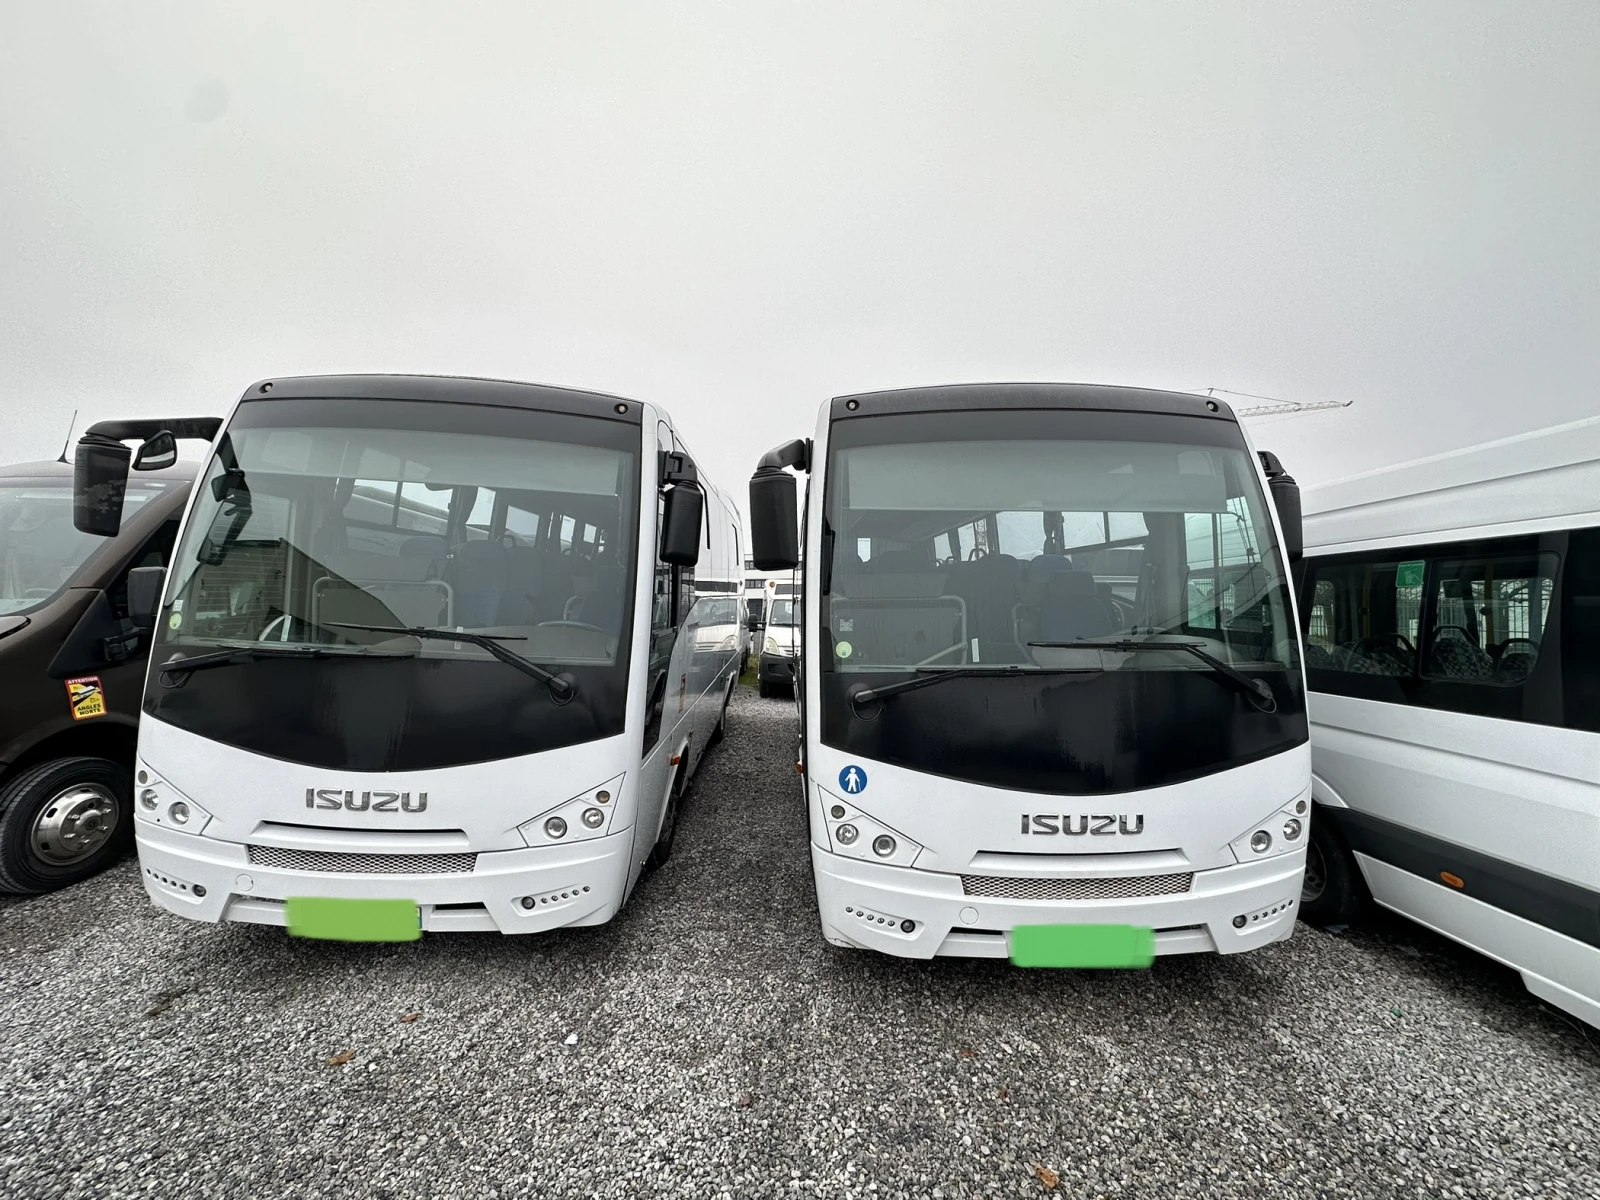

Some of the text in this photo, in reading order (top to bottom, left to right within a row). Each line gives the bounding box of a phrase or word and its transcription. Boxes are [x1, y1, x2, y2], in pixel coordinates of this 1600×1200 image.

[67, 676, 98, 684] ATTENTION
[77, 703, 101, 712] ANGLES
[305, 786, 428, 813] ISUZU
[1020, 812, 1144, 836] ISUZU
